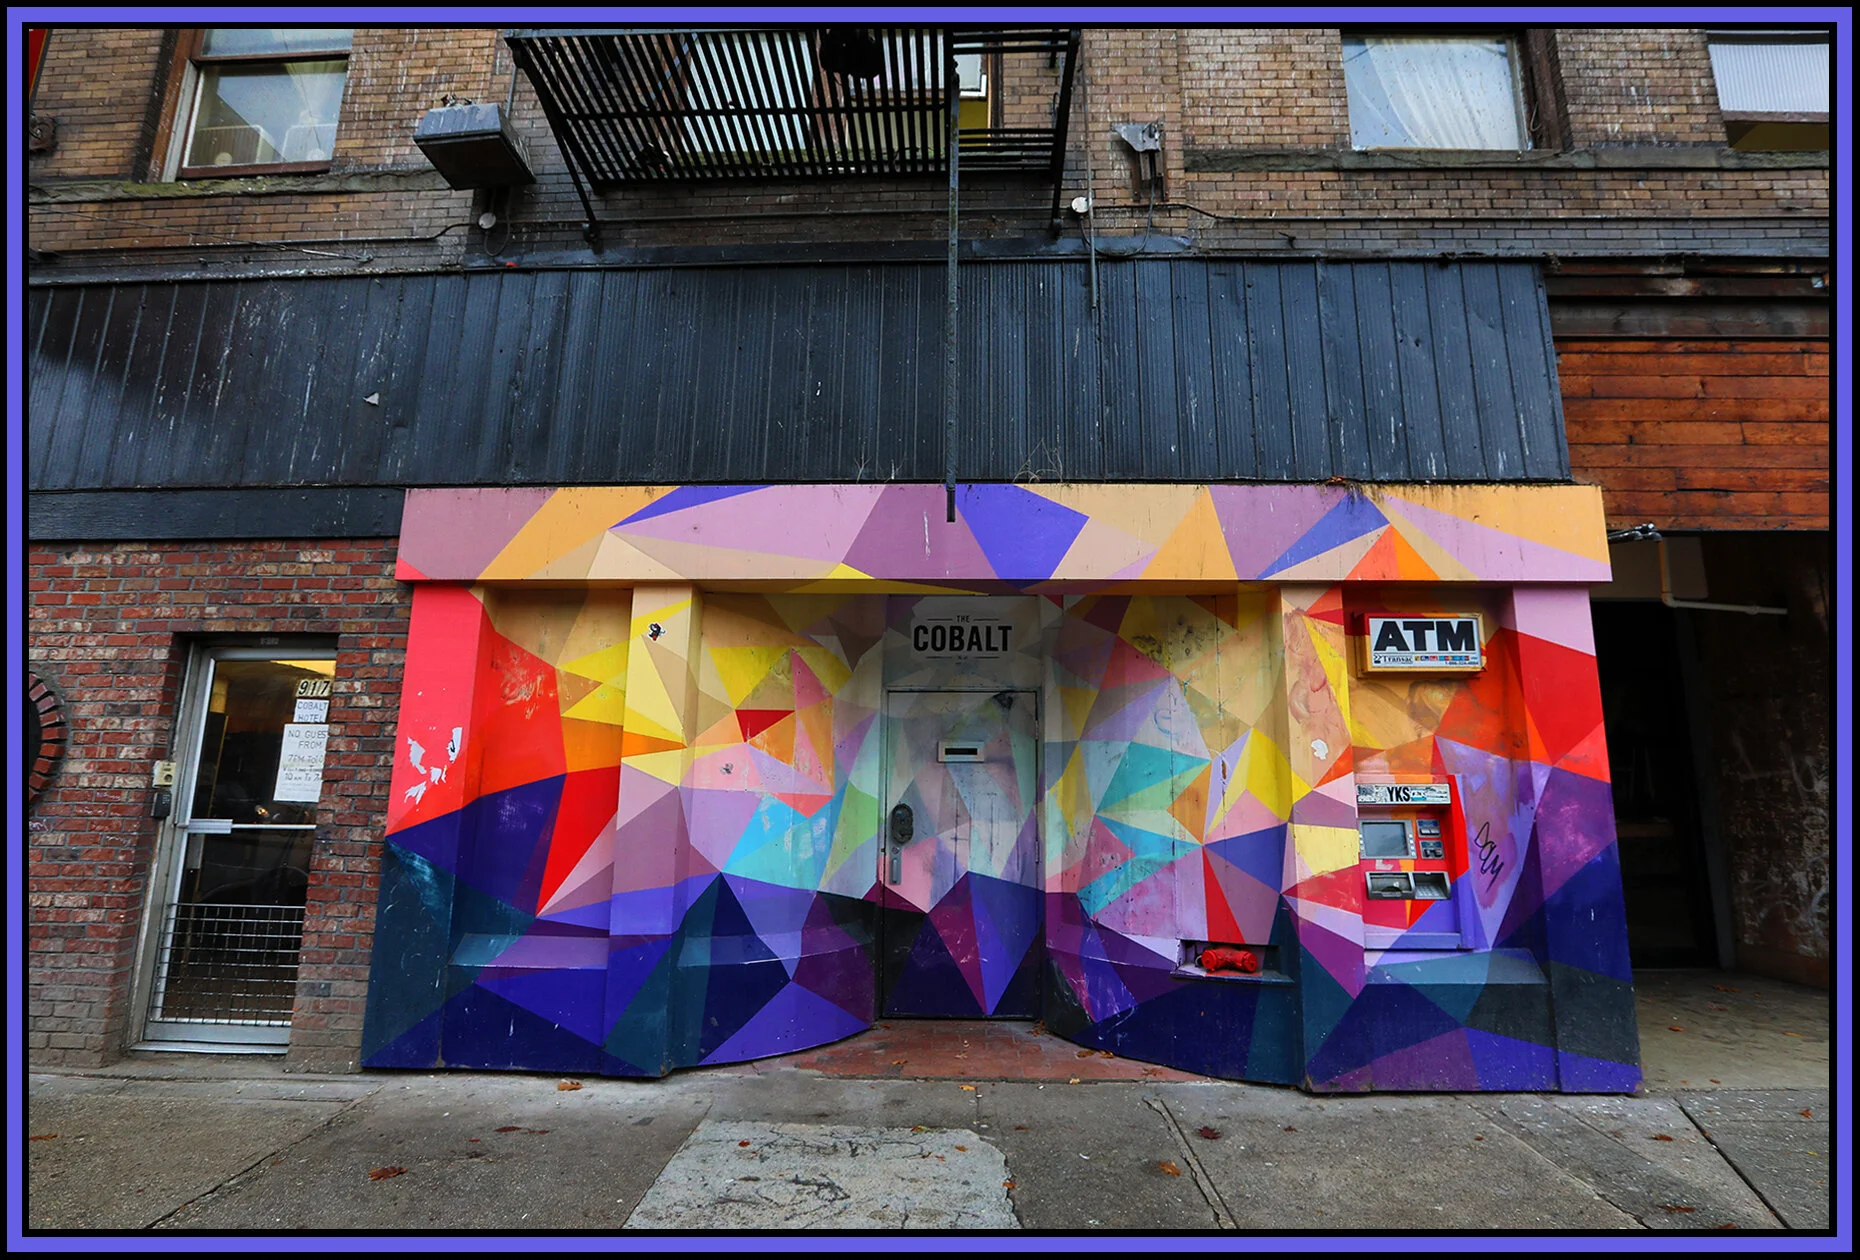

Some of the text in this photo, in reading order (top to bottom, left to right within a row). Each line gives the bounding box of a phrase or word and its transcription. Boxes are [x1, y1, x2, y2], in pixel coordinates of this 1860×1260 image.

[956, 615, 970, 623] THE
[913, 625, 1013, 651] COBALT
[1373, 621, 1476, 651] ATM
[298, 680, 331, 695] 917
[297, 701, 328, 711] COBALT
[298, 713, 323, 722] HOTEL
[288, 730, 300, 738] NO
[299, 740, 323, 749] FROM
[1387, 786, 1411, 802] YKS
